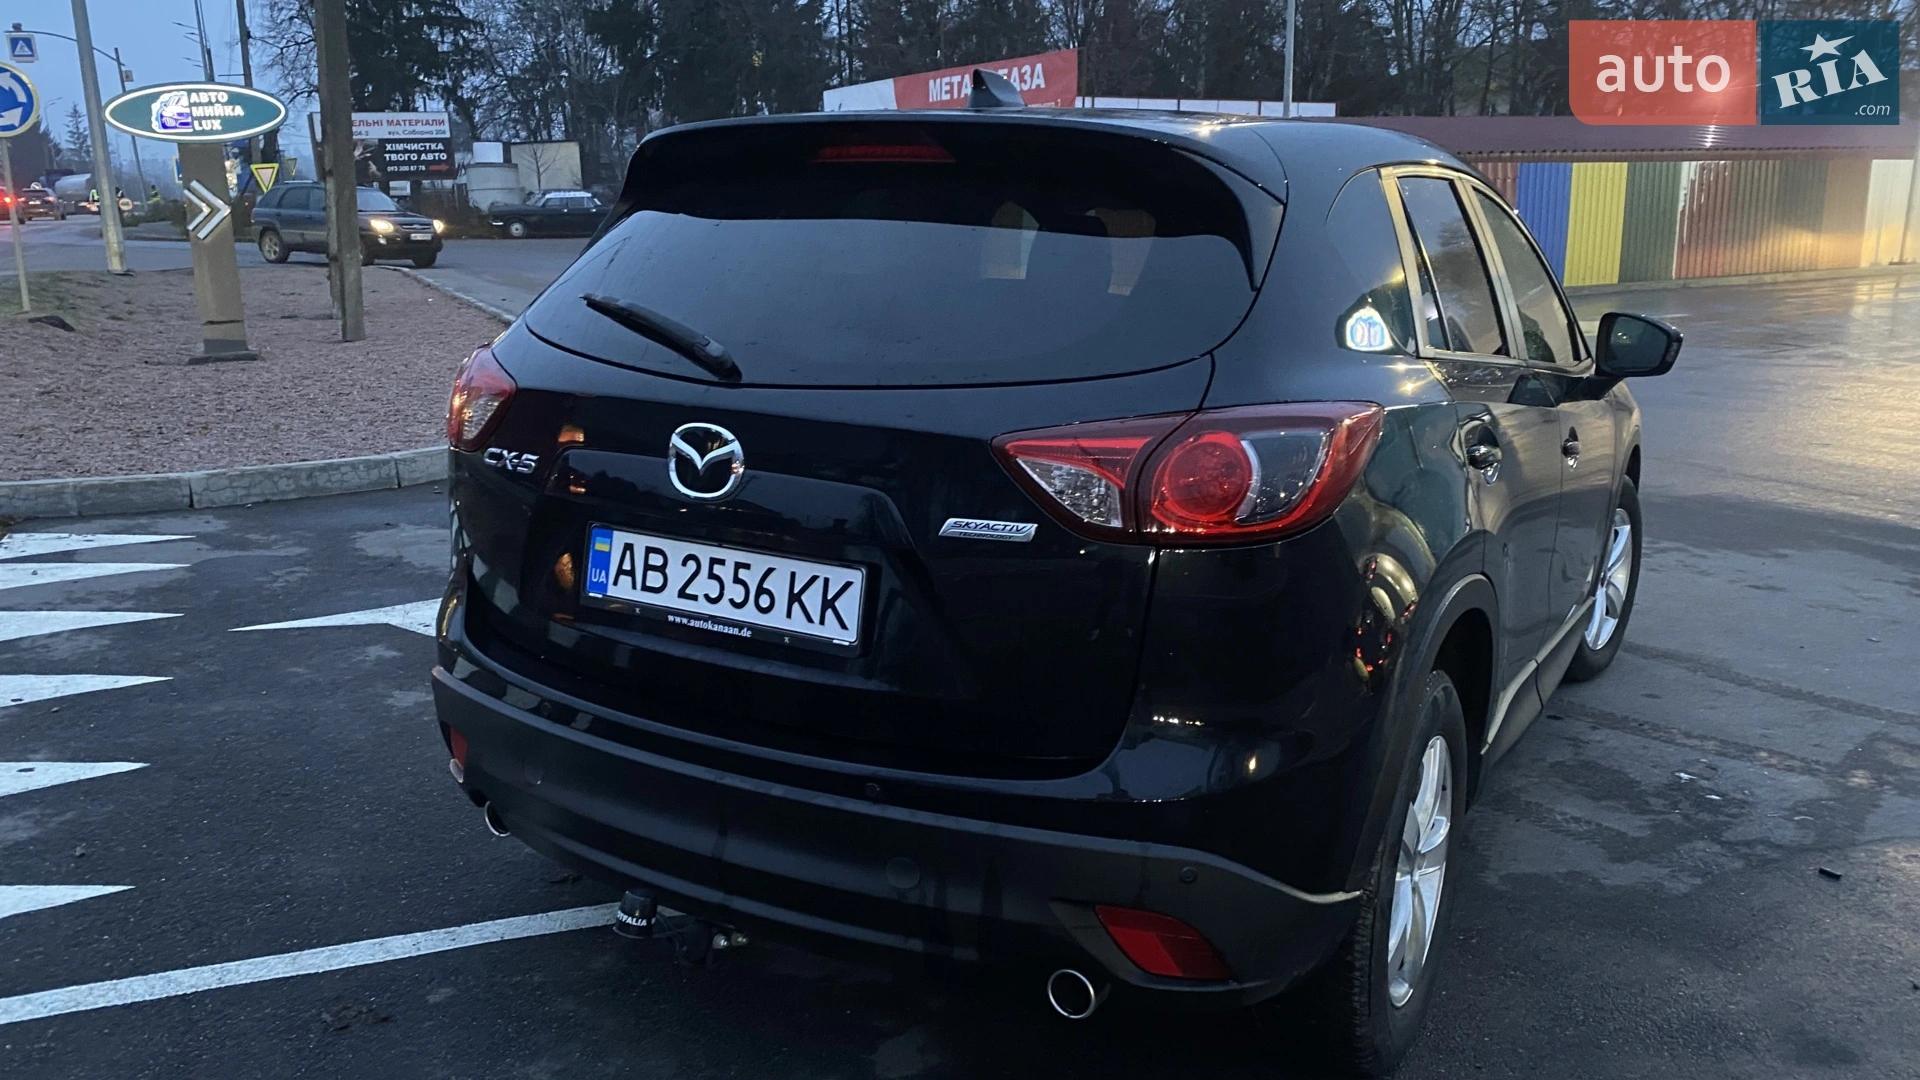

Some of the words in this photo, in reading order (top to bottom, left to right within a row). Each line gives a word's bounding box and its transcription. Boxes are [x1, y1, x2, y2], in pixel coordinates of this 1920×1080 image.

[929, 63, 1045, 102] МЕТААЗА
[190, 91, 228, 103] АВТО
[192, 103, 245, 118] МИЙКА
[194, 119, 223, 131] LUX
[352, 119, 383, 127] ЕЛЬНІ
[386, 118, 445, 127] МАТЕРІАЛИ
[385, 142, 444, 151] ХІМЧИСТКА
[383, 153, 418, 161] ТВОГО
[420, 152, 448, 160] АВТО
[483, 447, 540, 474] CX-5
[951, 521, 1027, 532] SKYACTIV
[591, 567, 607, 584] UA
[612, 542, 669, 594] AB
[677, 553, 777, 615] 2556
[785, 571, 855, 631] KK
[667, 614, 752, 638] www.autokanaan.de
